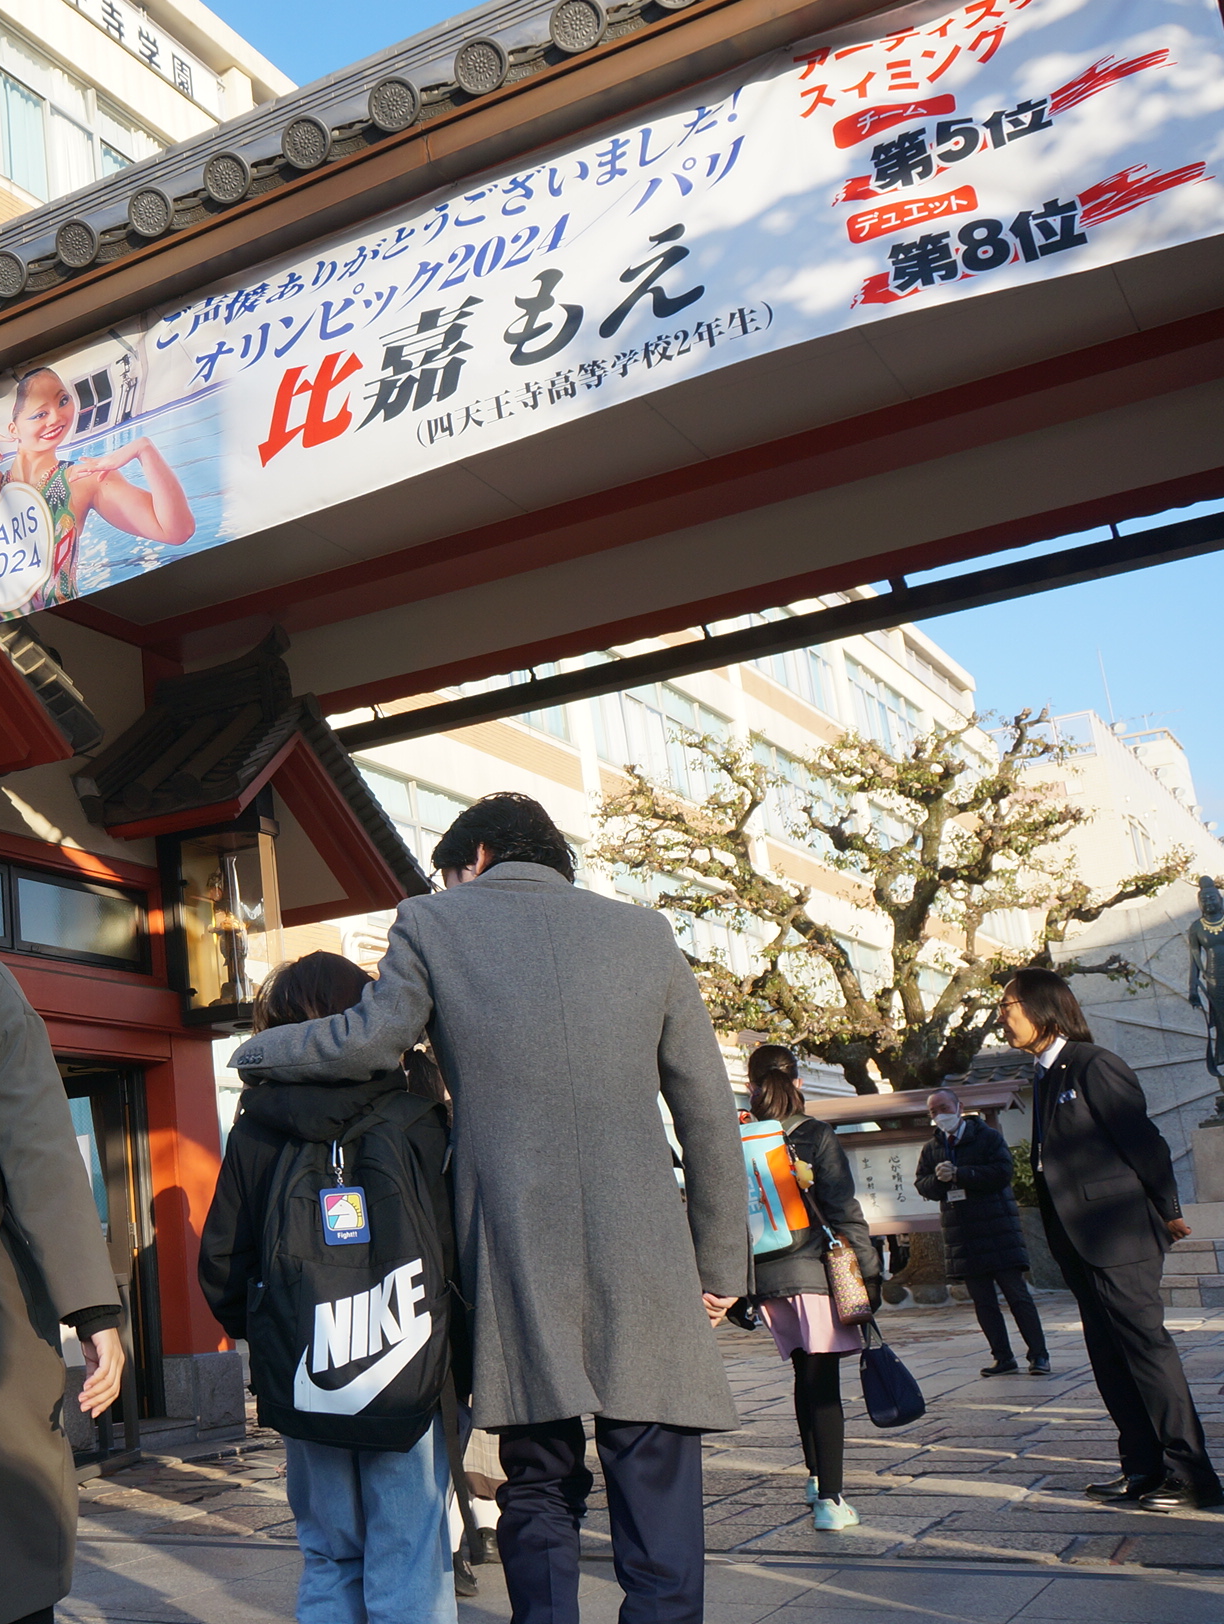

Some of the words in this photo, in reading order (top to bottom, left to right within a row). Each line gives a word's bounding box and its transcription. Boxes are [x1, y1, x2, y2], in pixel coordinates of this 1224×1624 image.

[793, 0, 1030, 80] アーティス
[800, 21, 1009, 118] スイミング
[857, 104, 927, 134] チーム
[870, 98, 1054, 190] 第5位
[854, 195, 968, 237] デュエット
[888, 198, 1088, 292] 第8位
[312, 1257, 431, 1374] NIKE
